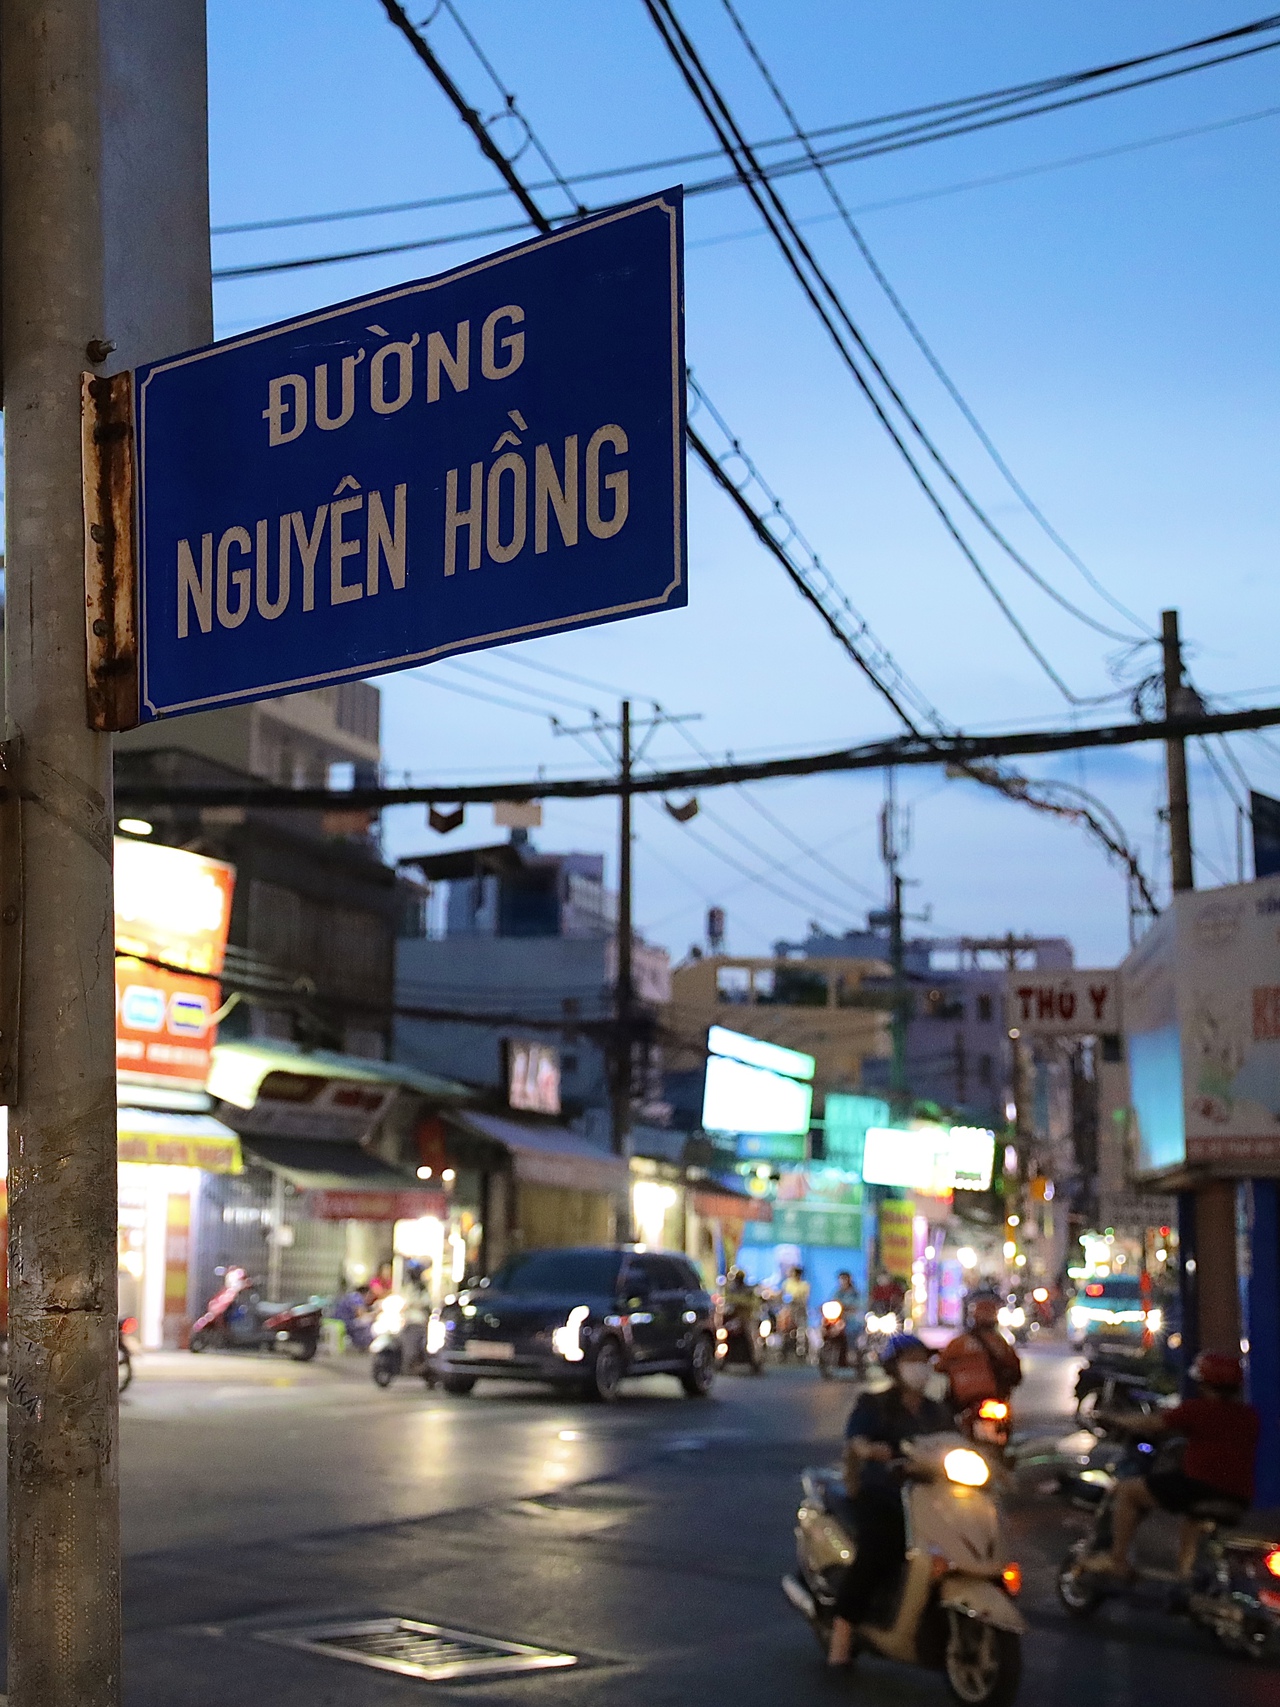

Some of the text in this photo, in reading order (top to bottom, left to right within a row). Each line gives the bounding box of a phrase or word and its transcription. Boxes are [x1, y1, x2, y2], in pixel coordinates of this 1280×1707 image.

[262, 304, 526, 448] ĐƯỜNG
[176, 409, 630, 639] NGUYÊN HỒNG
[1088, 984, 1109, 1020] Y
